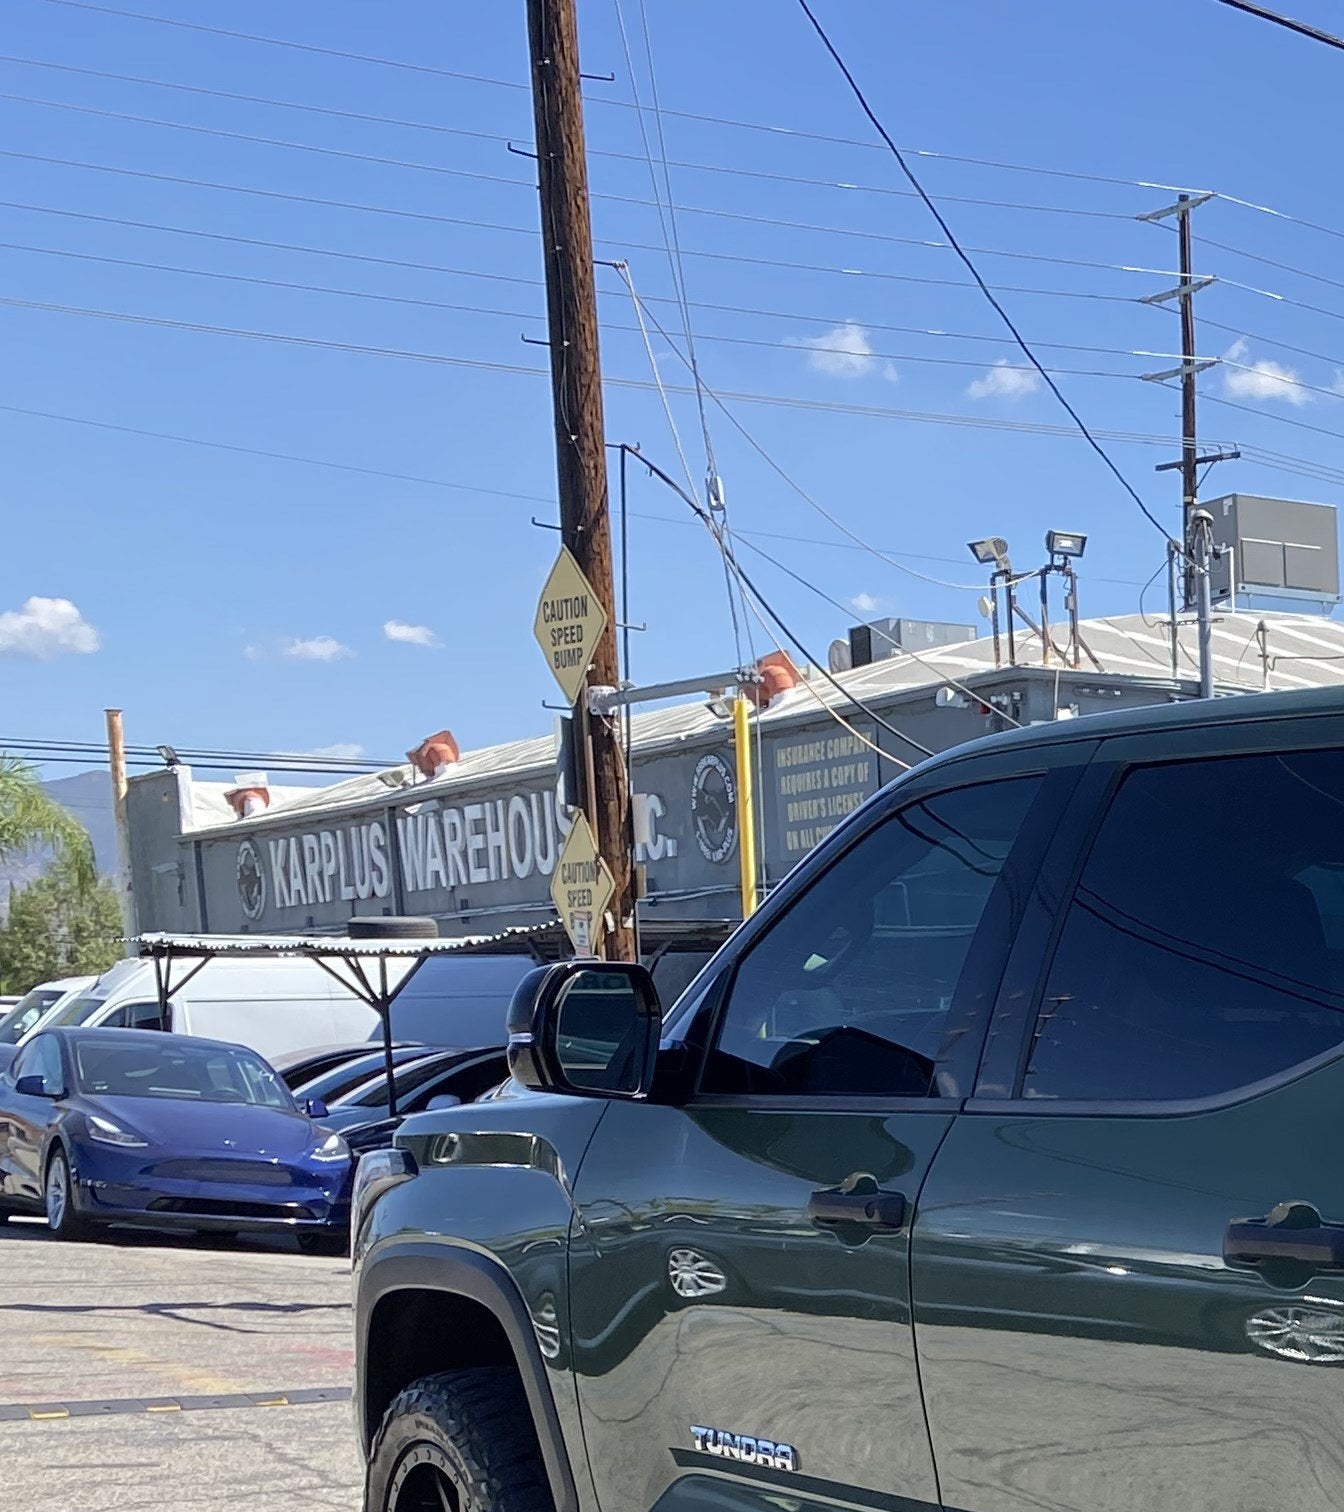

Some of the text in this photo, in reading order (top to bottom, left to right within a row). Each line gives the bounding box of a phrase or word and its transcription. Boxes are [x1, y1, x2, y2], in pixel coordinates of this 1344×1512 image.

[542, 595, 588, 624] CAUTION
[550, 624, 584, 647] SPEED
[553, 647, 584, 670] BUMP
[777, 741, 826, 768] INSURANCE
[824, 768, 830, 789] A
[831, 763, 856, 788] COPY
[857, 762, 869, 783] OF
[268, 822, 390, 909] KARPLUS
[400, 779, 574, 892] WAREHOUS
[561, 862, 598, 885] CAUTION
[567, 889, 593, 908] SPEED
[689, 1424, 797, 1471] TUNDRA
